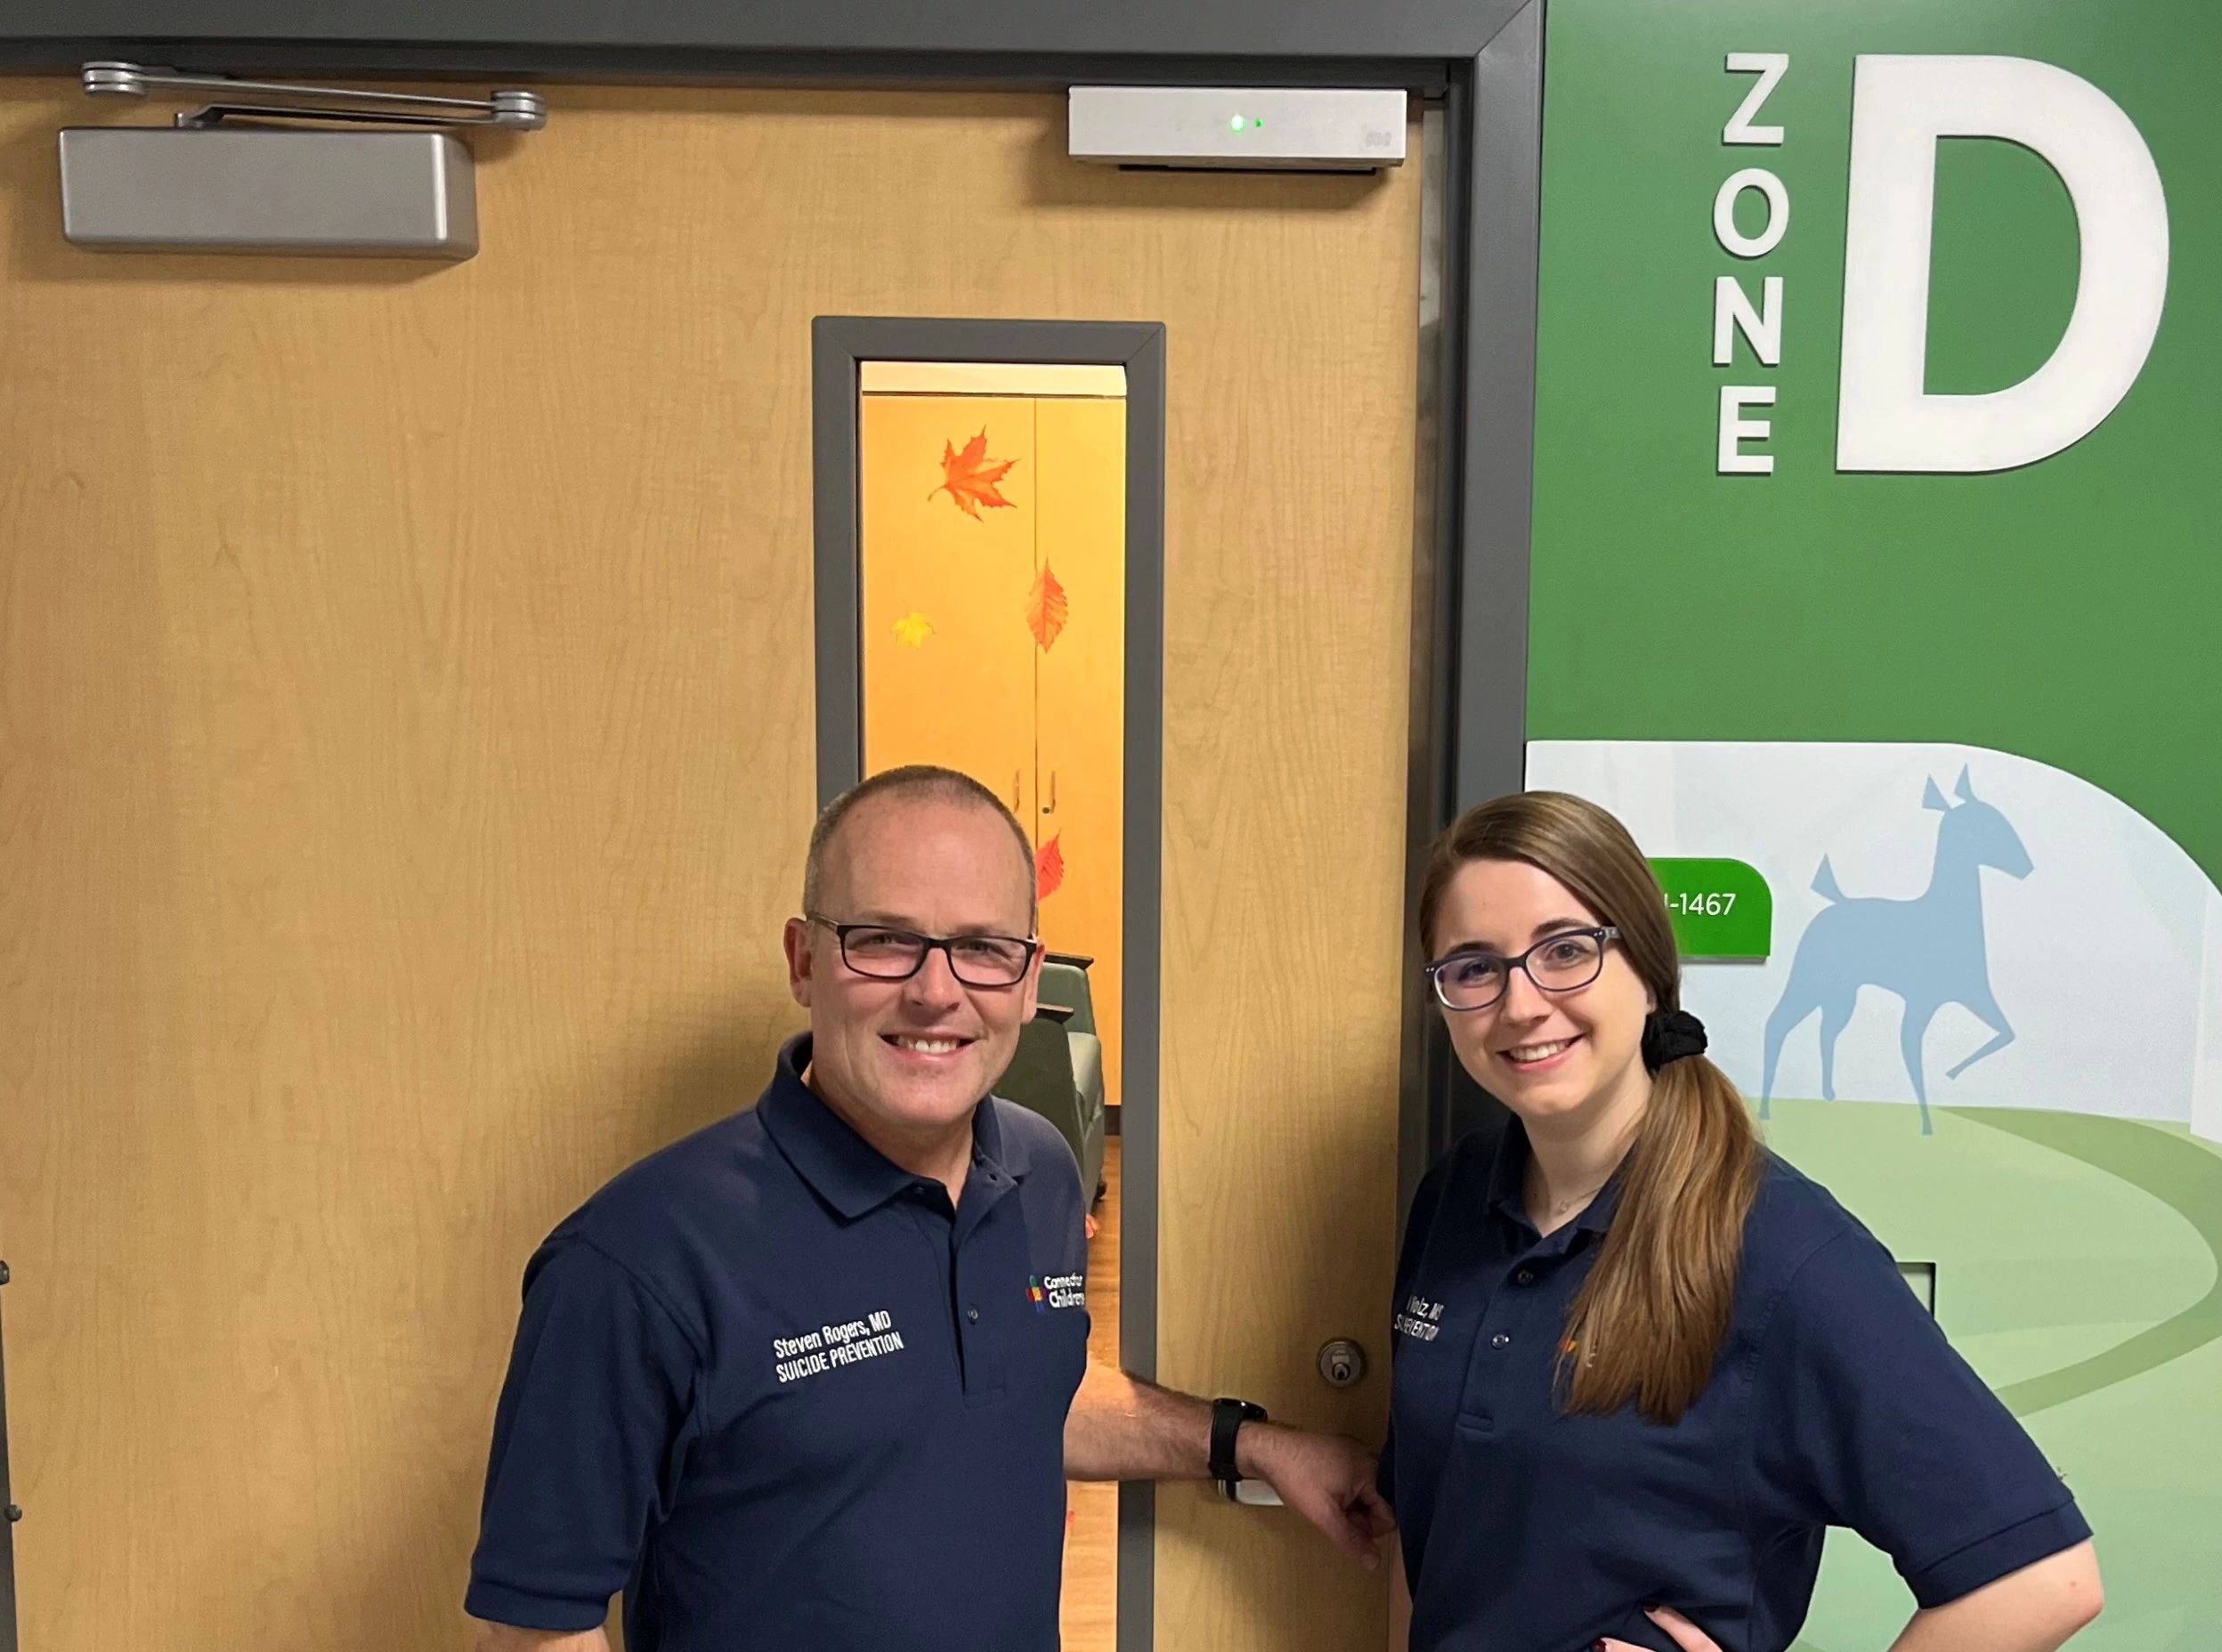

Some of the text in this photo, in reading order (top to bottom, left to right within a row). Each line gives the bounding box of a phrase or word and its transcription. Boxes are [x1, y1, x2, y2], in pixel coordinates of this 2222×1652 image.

[1713, 53, 1789, 474] ZONE
[1836, 54, 2169, 473] D
[1663, 892, 1736, 916] -1467
[774, 1310, 891, 1358] Steven Rogers, MD
[775, 1331, 904, 1383] SUICIDE PREVENTION
